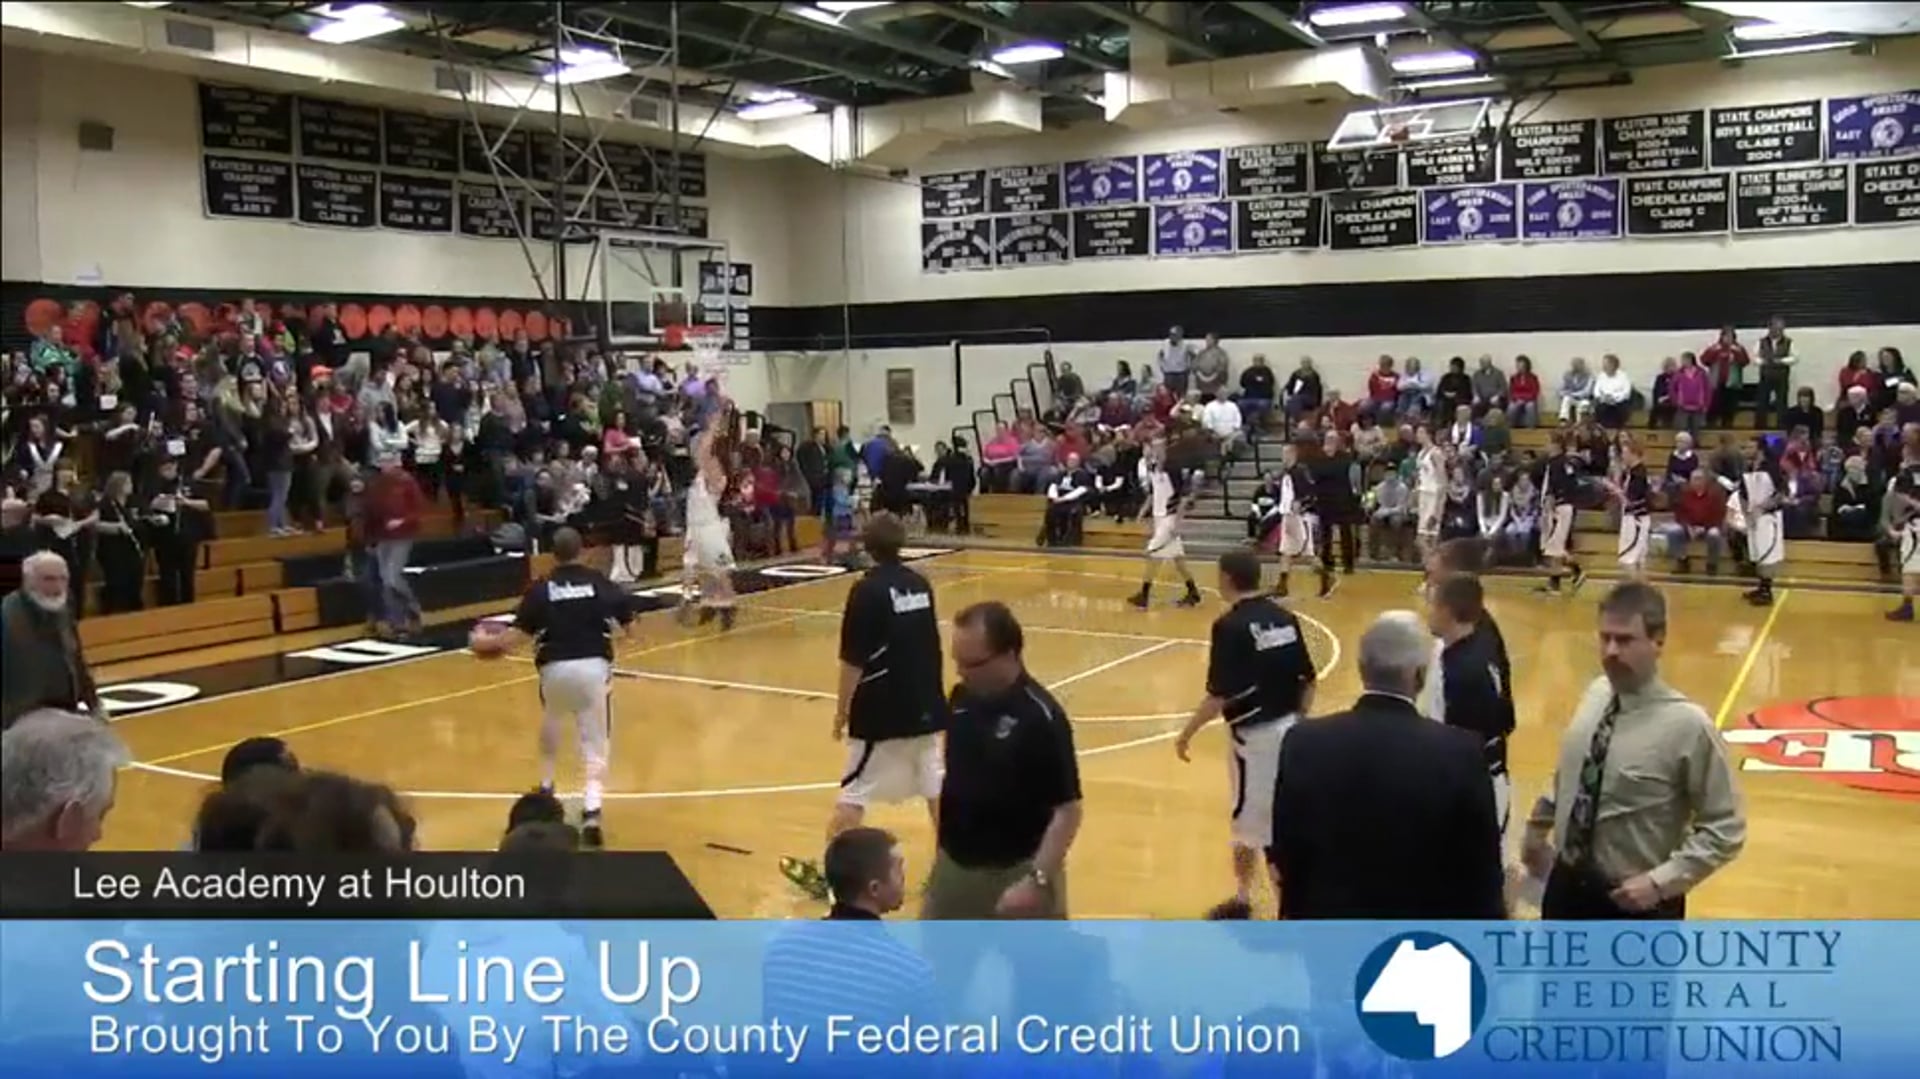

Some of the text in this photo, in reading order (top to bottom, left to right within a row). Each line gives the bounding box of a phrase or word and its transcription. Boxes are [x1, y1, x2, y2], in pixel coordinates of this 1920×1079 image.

[1718, 104, 1814, 124] STATE CHAMPIONS
[1511, 124, 1553, 138] EASTERN
[1613, 116, 1659, 131] EASTERN
[1715, 119, 1816, 139] BOYS BASKETBALL
[1618, 125, 1688, 141] CHAMPIONS
[1516, 133, 1581, 149] CHAMPIONS
[1736, 135, 1794, 150] CLASS C
[1746, 150, 1783, 161] 2004
[1523, 165, 1562, 177] CLASS
[1627, 158, 1668, 171] CLASS
[1864, 164, 1902, 179] STATE
[1633, 176, 1723, 193] STATE CHAMPIONS
[1740, 172, 1772, 186] STATE
[1360, 195, 1416, 212] CHAMPIONS
[1631, 191, 1726, 207] CHEERLEADING
[1650, 206, 1693, 219] CLASS
[1763, 212, 1807, 226] CLASS
[1349, 223, 1386, 235] CLASS
